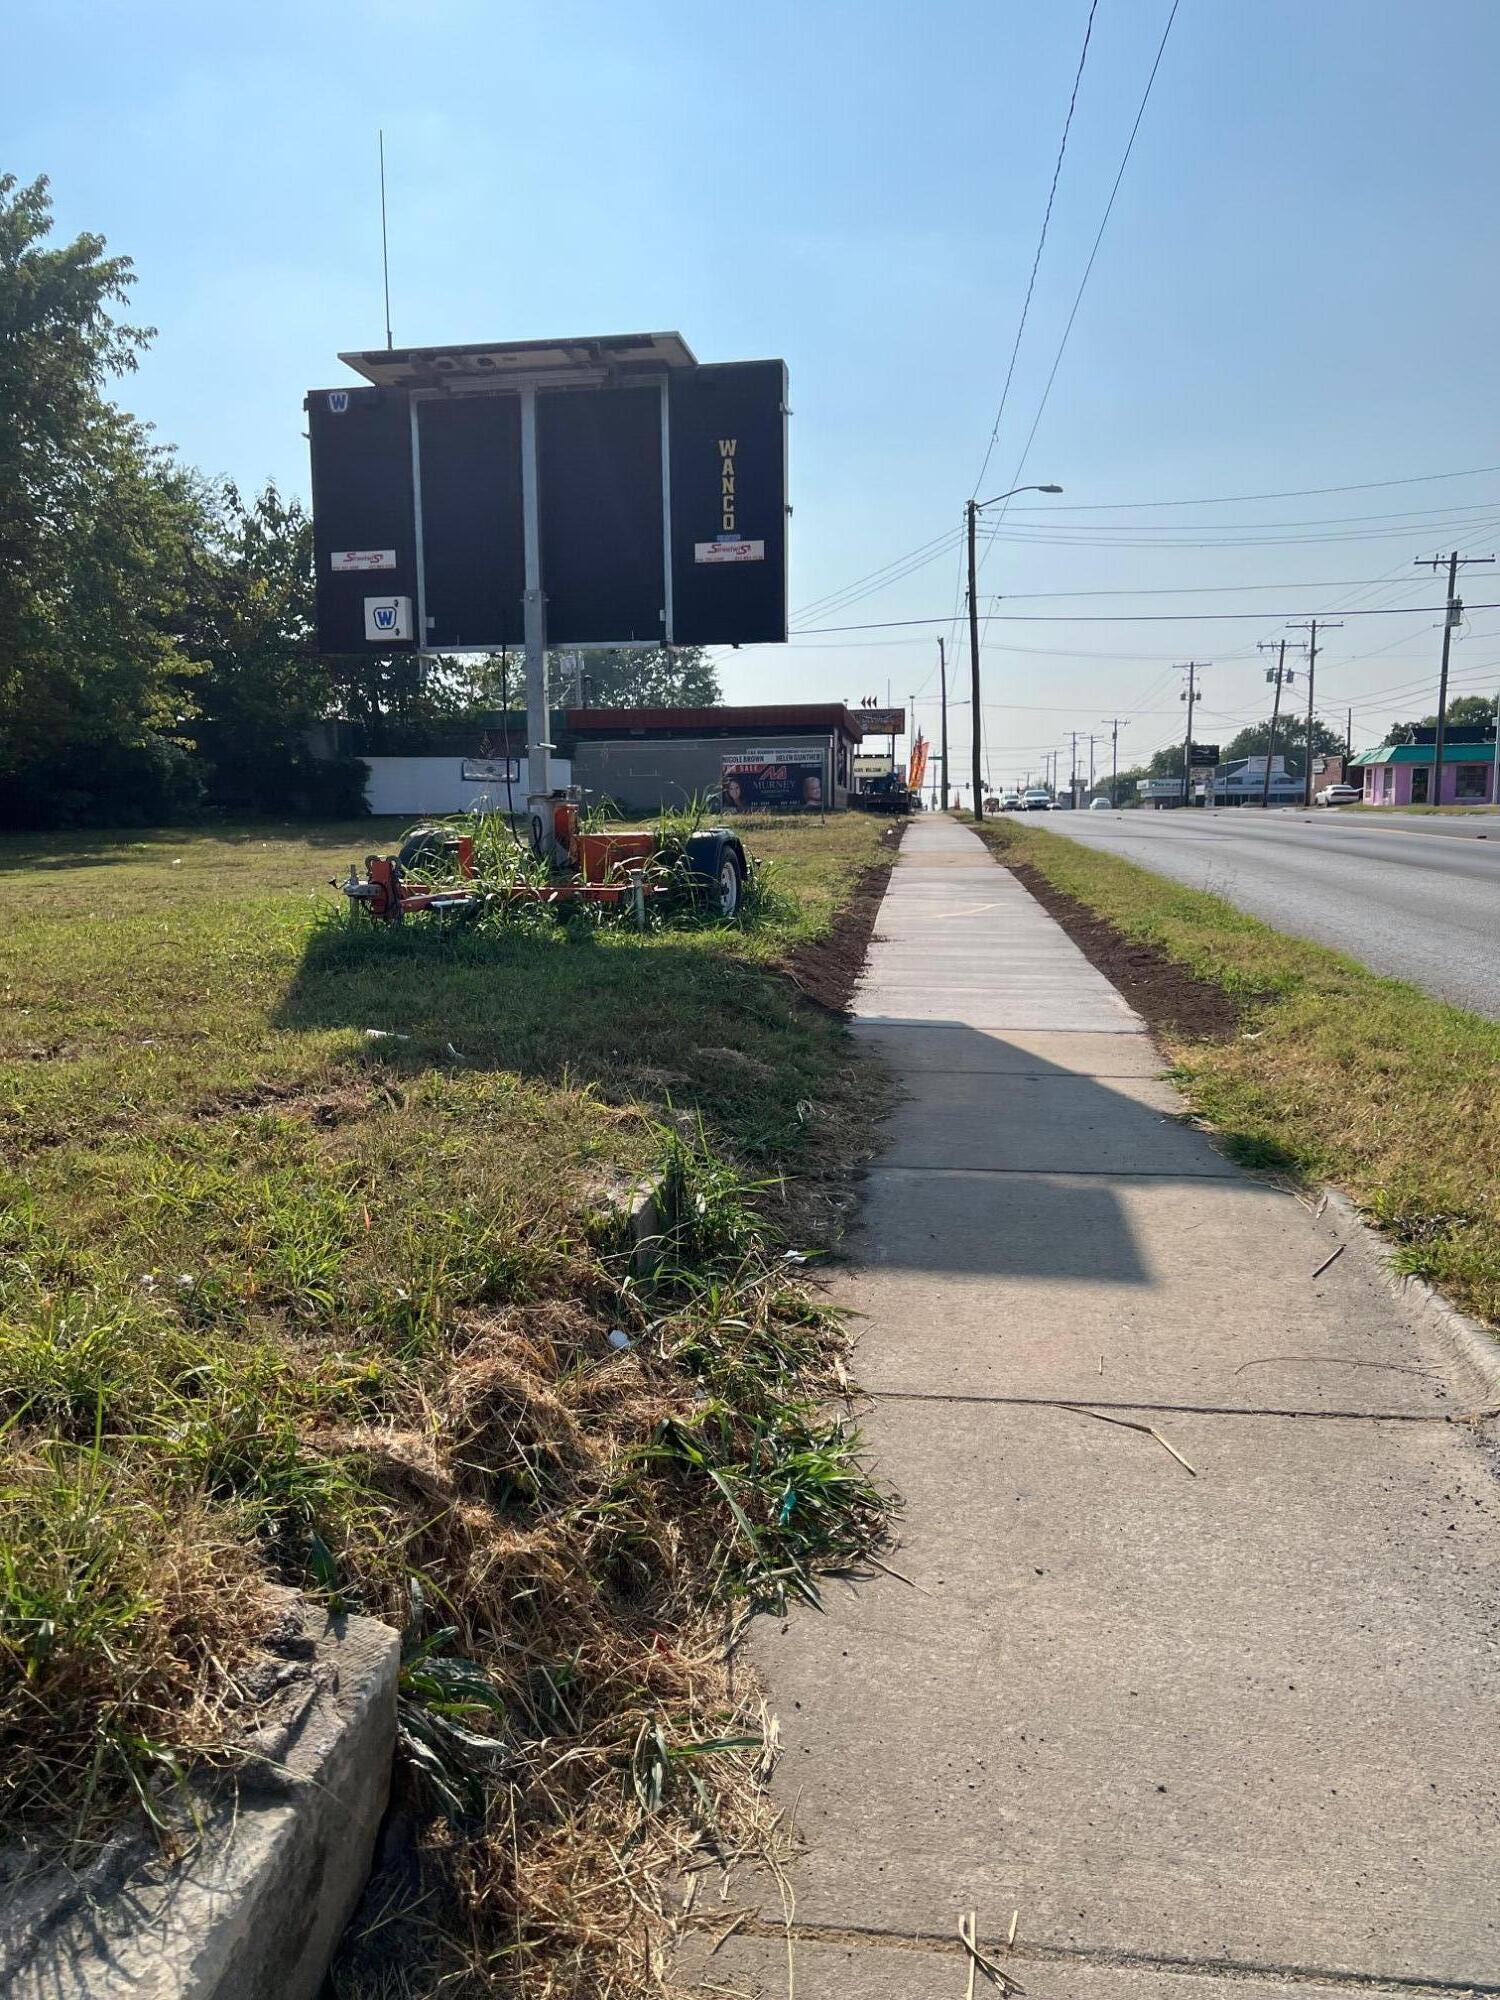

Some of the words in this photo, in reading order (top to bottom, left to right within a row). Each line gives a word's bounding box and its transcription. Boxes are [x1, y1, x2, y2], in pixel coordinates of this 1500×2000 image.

[718, 439, 737, 530] WANCO
[376, 610, 395, 627] W
[753, 780, 794, 790] MURNEY
